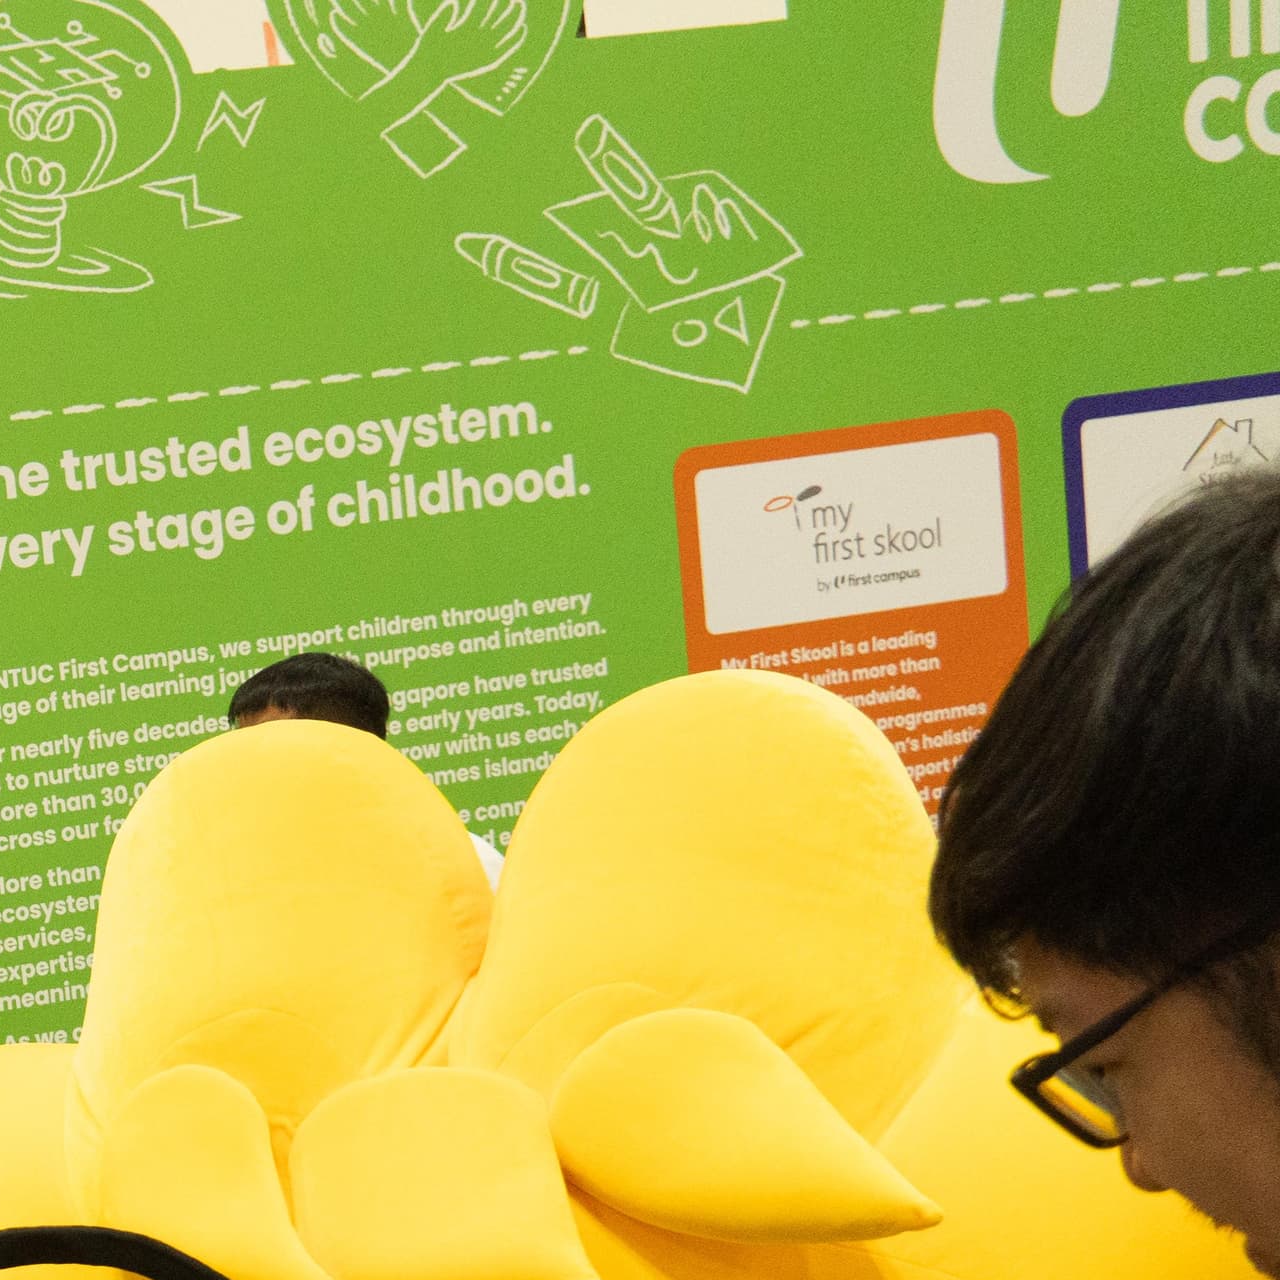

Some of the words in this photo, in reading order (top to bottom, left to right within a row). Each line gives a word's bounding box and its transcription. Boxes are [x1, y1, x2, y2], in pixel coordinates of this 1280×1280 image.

[59, 425, 252, 491] trusted
[264, 402, 552, 467] ecosystem.
[108, 506, 255, 560] stage
[267, 484, 315, 535] of
[327, 453, 591, 528] childhood.
[811, 501, 853, 533] my
[813, 531, 865, 563] first
[873, 516, 942, 556] skool
[848, 573, 872, 587] first
[873, 568, 921, 583] campus
[59, 656, 109, 681] First
[112, 645, 215, 674] Campus,
[219, 639, 251, 658] we
[256, 624, 343, 655] support
[347, 614, 438, 641] children
[441, 599, 528, 626] through
[532, 592, 592, 615] every
[366, 640, 455, 670] purpose
[459, 631, 500, 654] and
[505, 618, 607, 648] intention.
[750, 651, 789, 669] First
[790, 641, 838, 664] Skool
[840, 640, 855, 658] is
[857, 641, 868, 655] a
[872, 630, 938, 653] leading
[388, 681, 470, 712] gapore
[474, 671, 527, 695] have
[531, 657, 608, 686] trusted
[852, 663, 898, 682] more
[900, 656, 940, 675] than
[35, 690, 58, 714] of
[62, 685, 116, 711] their
[120, 673, 215, 703] learning
[406, 709, 461, 733] early
[465, 702, 531, 730] years.
[534, 690, 604, 715] Today,
[11, 735, 83, 761] nearly
[88, 728, 129, 751] five
[400, 742, 441, 761] row
[444, 732, 492, 755] with
[496, 731, 522, 748] us
[525, 719, 578, 743] each
[5, 772, 28, 791] to
[34, 761, 120, 787] nurture
[426, 765, 480, 786] mes
[484, 751, 559, 779] island
[42, 793, 96, 815] than
[101, 782, 147, 807] 30,0
[61, 821, 99, 842] our
[47, 864, 101, 887] than
